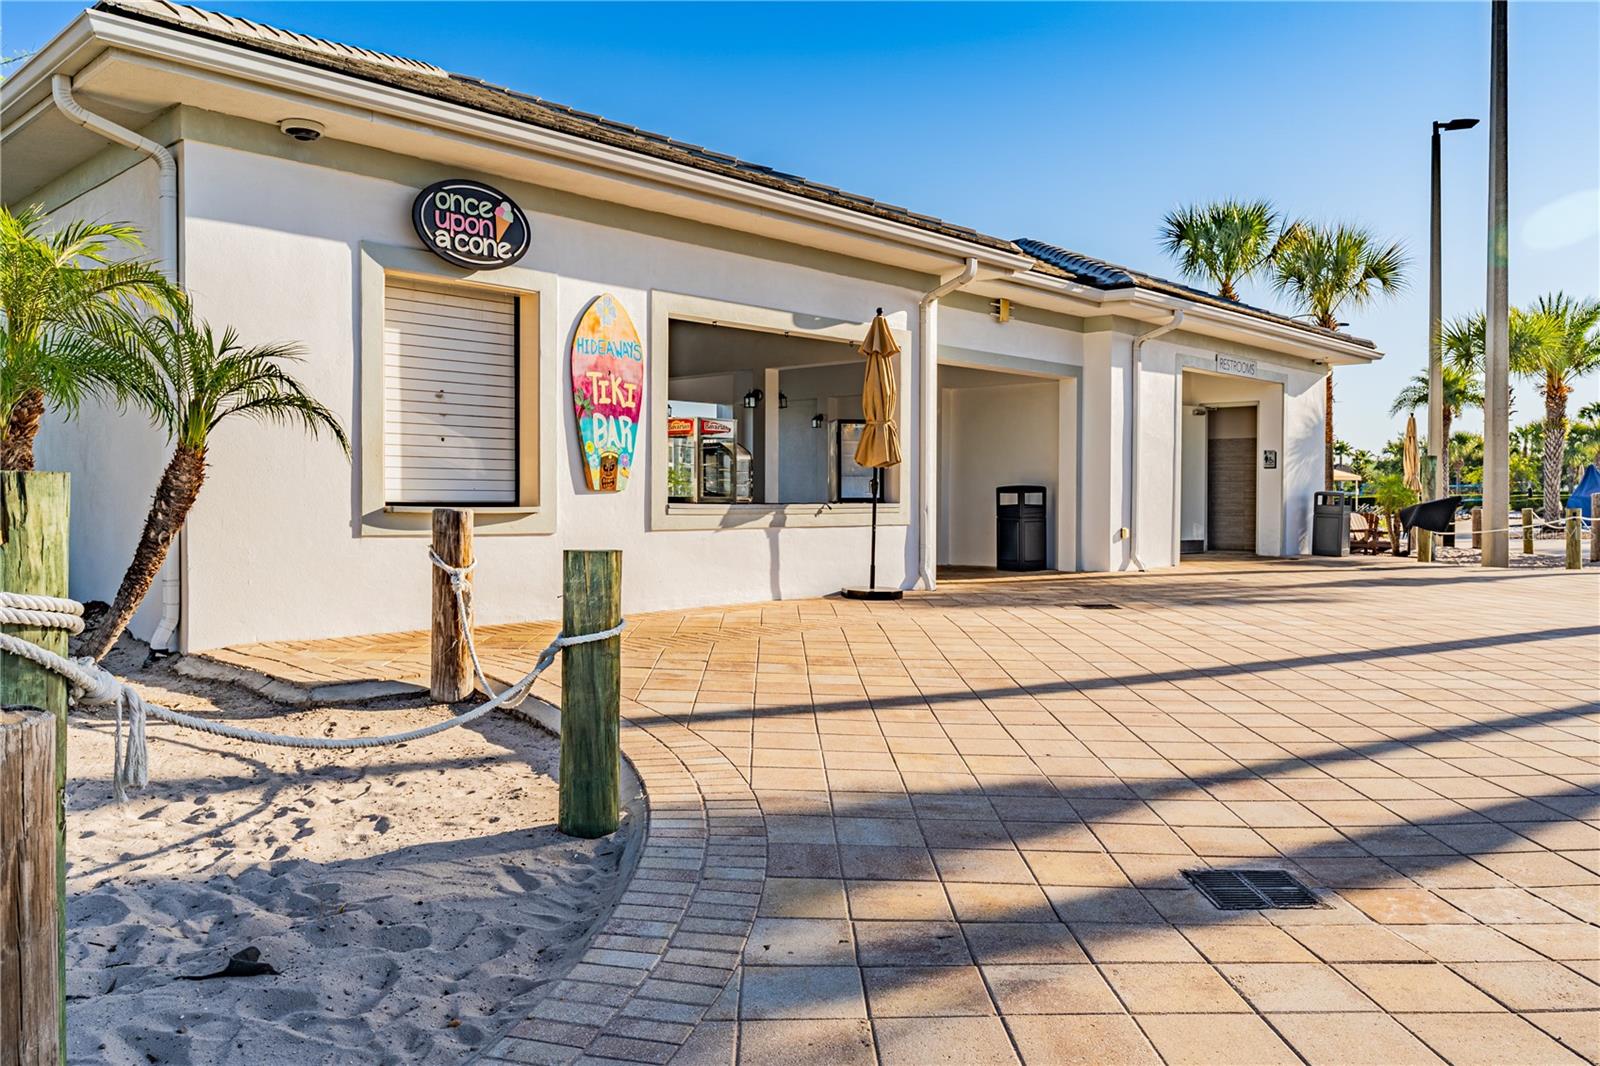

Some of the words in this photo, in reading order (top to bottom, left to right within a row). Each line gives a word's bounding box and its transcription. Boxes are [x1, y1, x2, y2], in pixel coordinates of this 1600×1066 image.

[435, 191, 493, 218] once
[434, 210, 494, 238] upon
[434, 229, 452, 250] a
[454, 233, 512, 259] cone
[576, 337, 642, 361] HIDEAWAYS
[1219, 357, 1255, 376] RESTROOMS
[586, 371, 637, 408] TIKI
[592, 412, 633, 453] BAR
